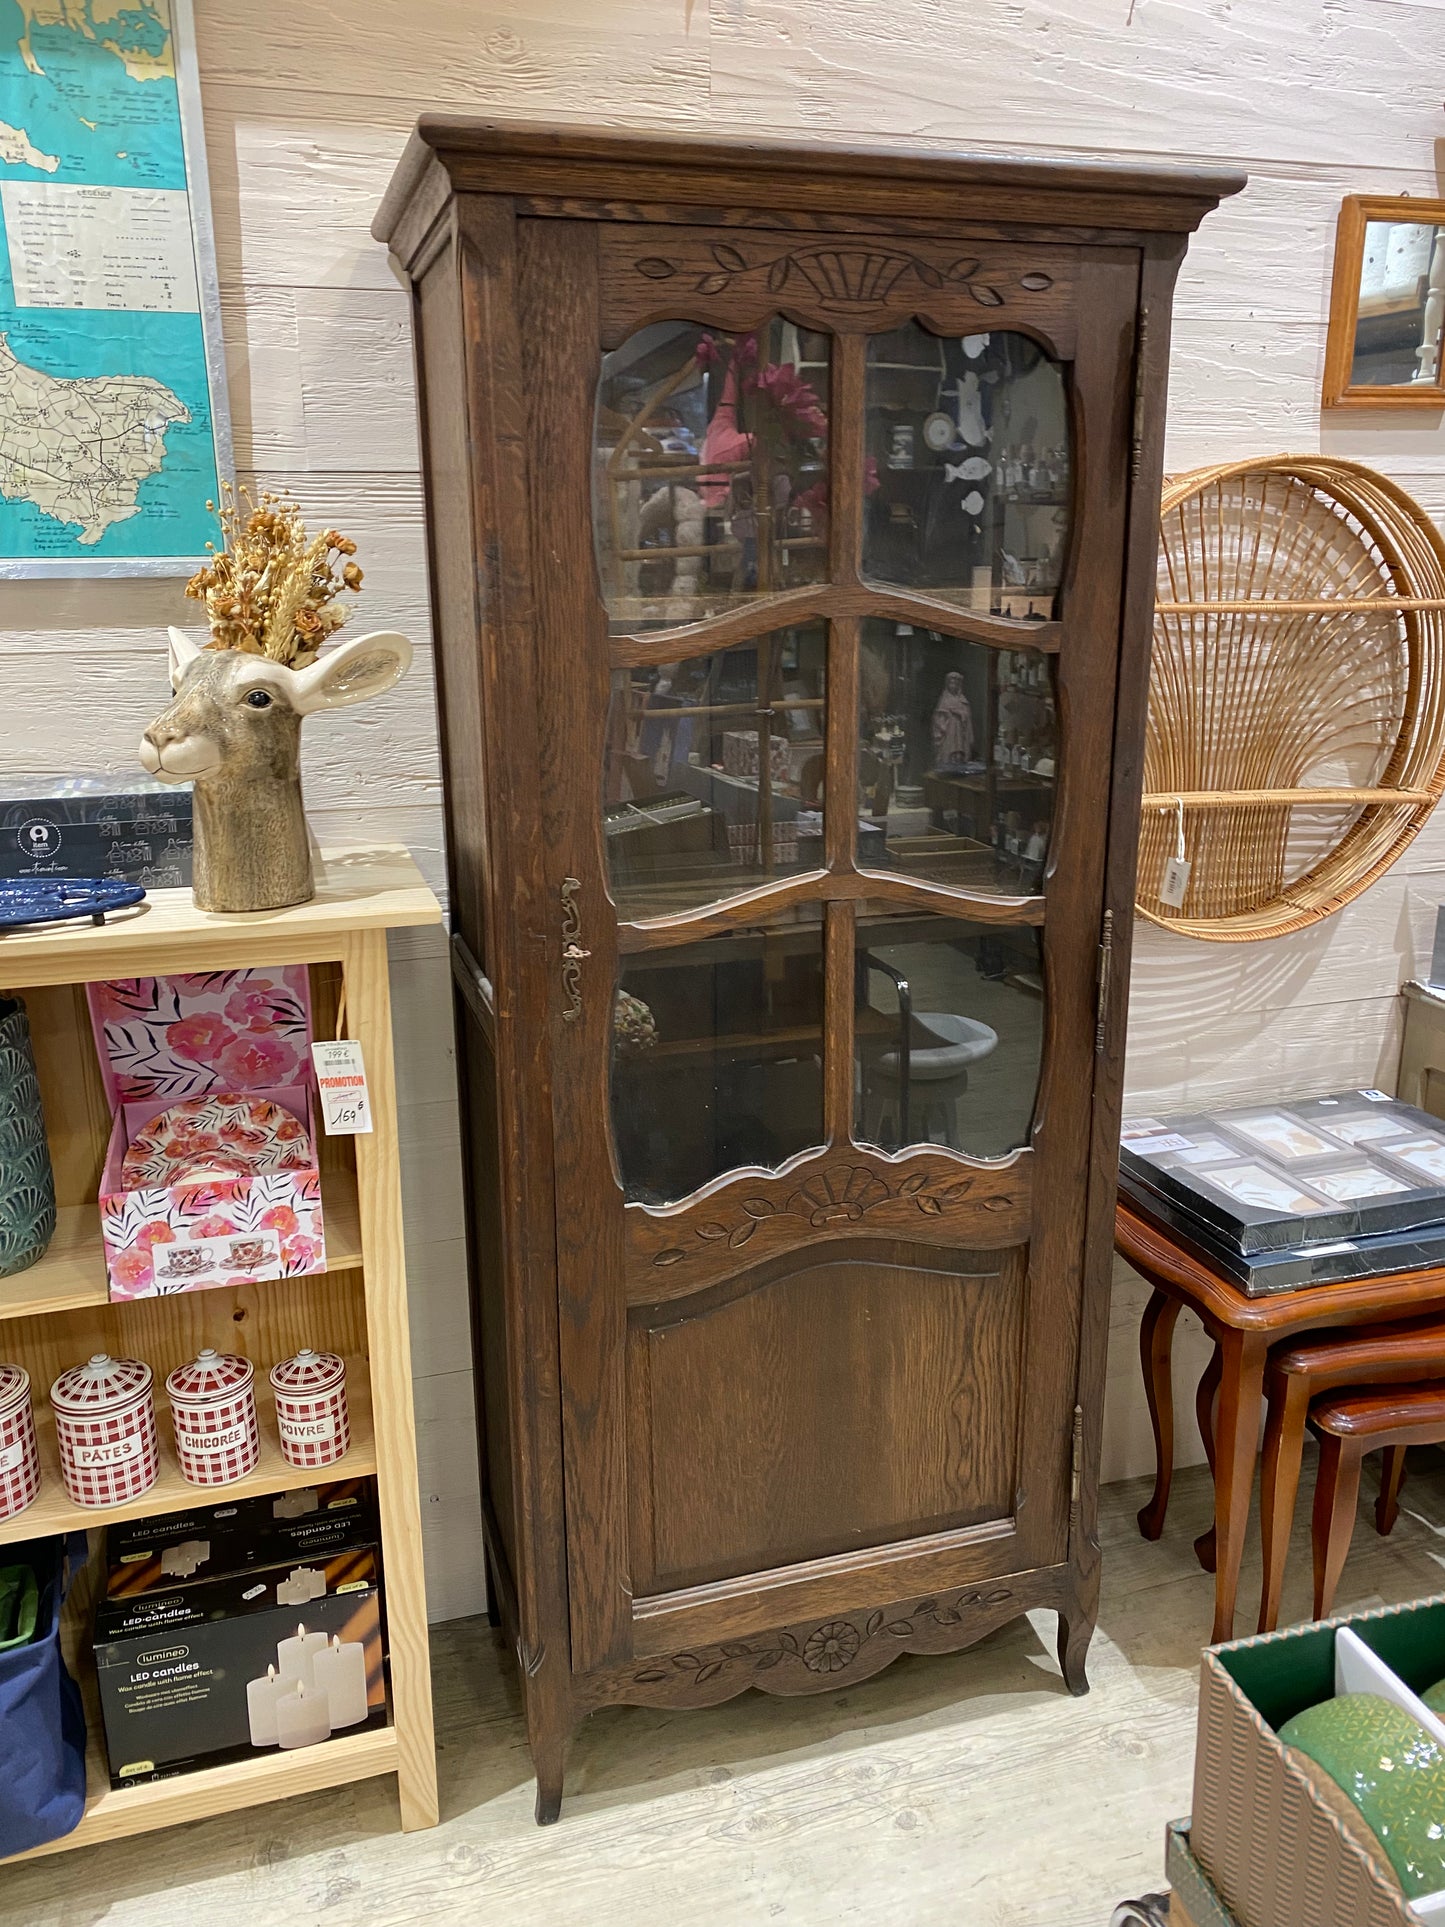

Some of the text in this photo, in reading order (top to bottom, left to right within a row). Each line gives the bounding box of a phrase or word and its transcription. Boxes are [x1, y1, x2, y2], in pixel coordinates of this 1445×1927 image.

[320, 1076, 364, 1088] PROMOTION
[184, 1428, 242, 1449] CHICORÉE
[280, 1422, 326, 1438] POIVRE
[82, 1441, 133, 1464] PÂTES
[132, 1521, 195, 1537] LED candles
[139, 1599, 180, 1611] lumineo
[123, 1609, 191, 1627] LED candles
[142, 1648, 185, 1663] lumineo
[130, 1662, 200, 1683] LED candles
[133, 1681, 157, 1690] candle
[157, 1678, 173, 1686] with
[173, 1674, 193, 1683] flame
[193, 1669, 214, 1678] effect
